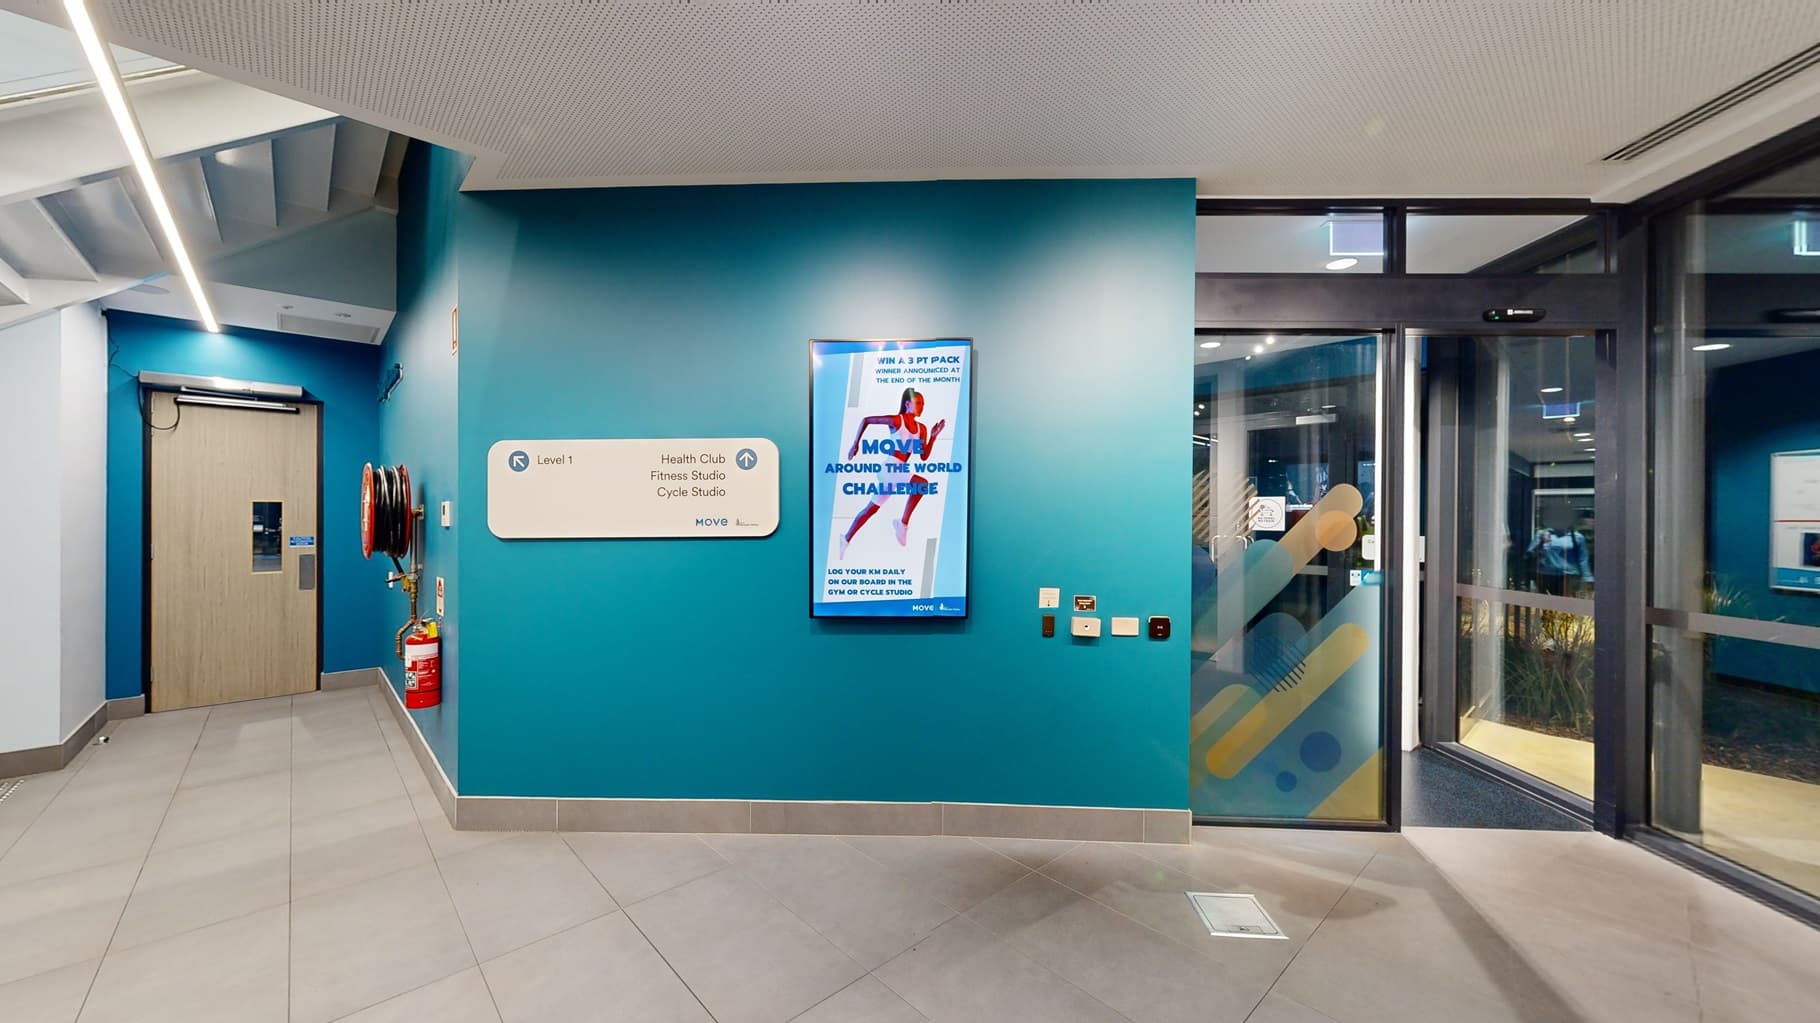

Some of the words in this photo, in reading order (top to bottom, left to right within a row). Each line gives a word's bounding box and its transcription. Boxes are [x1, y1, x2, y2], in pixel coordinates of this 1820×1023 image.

[862, 440, 924, 455] MOVE
[537, 455, 565, 465] Level
[661, 454, 696, 464] Health
[699, 453, 726, 464] Club
[825, 464, 881, 473] AROUND
[886, 464, 910, 473] THE
[914, 463, 962, 472] WORLD
[651, 470, 688, 481] Fitness
[691, 470, 726, 480] Studio
[657, 487, 688, 499] Cycle
[691, 486, 726, 497] Studio
[843, 483, 938, 495] CHALLENGE
